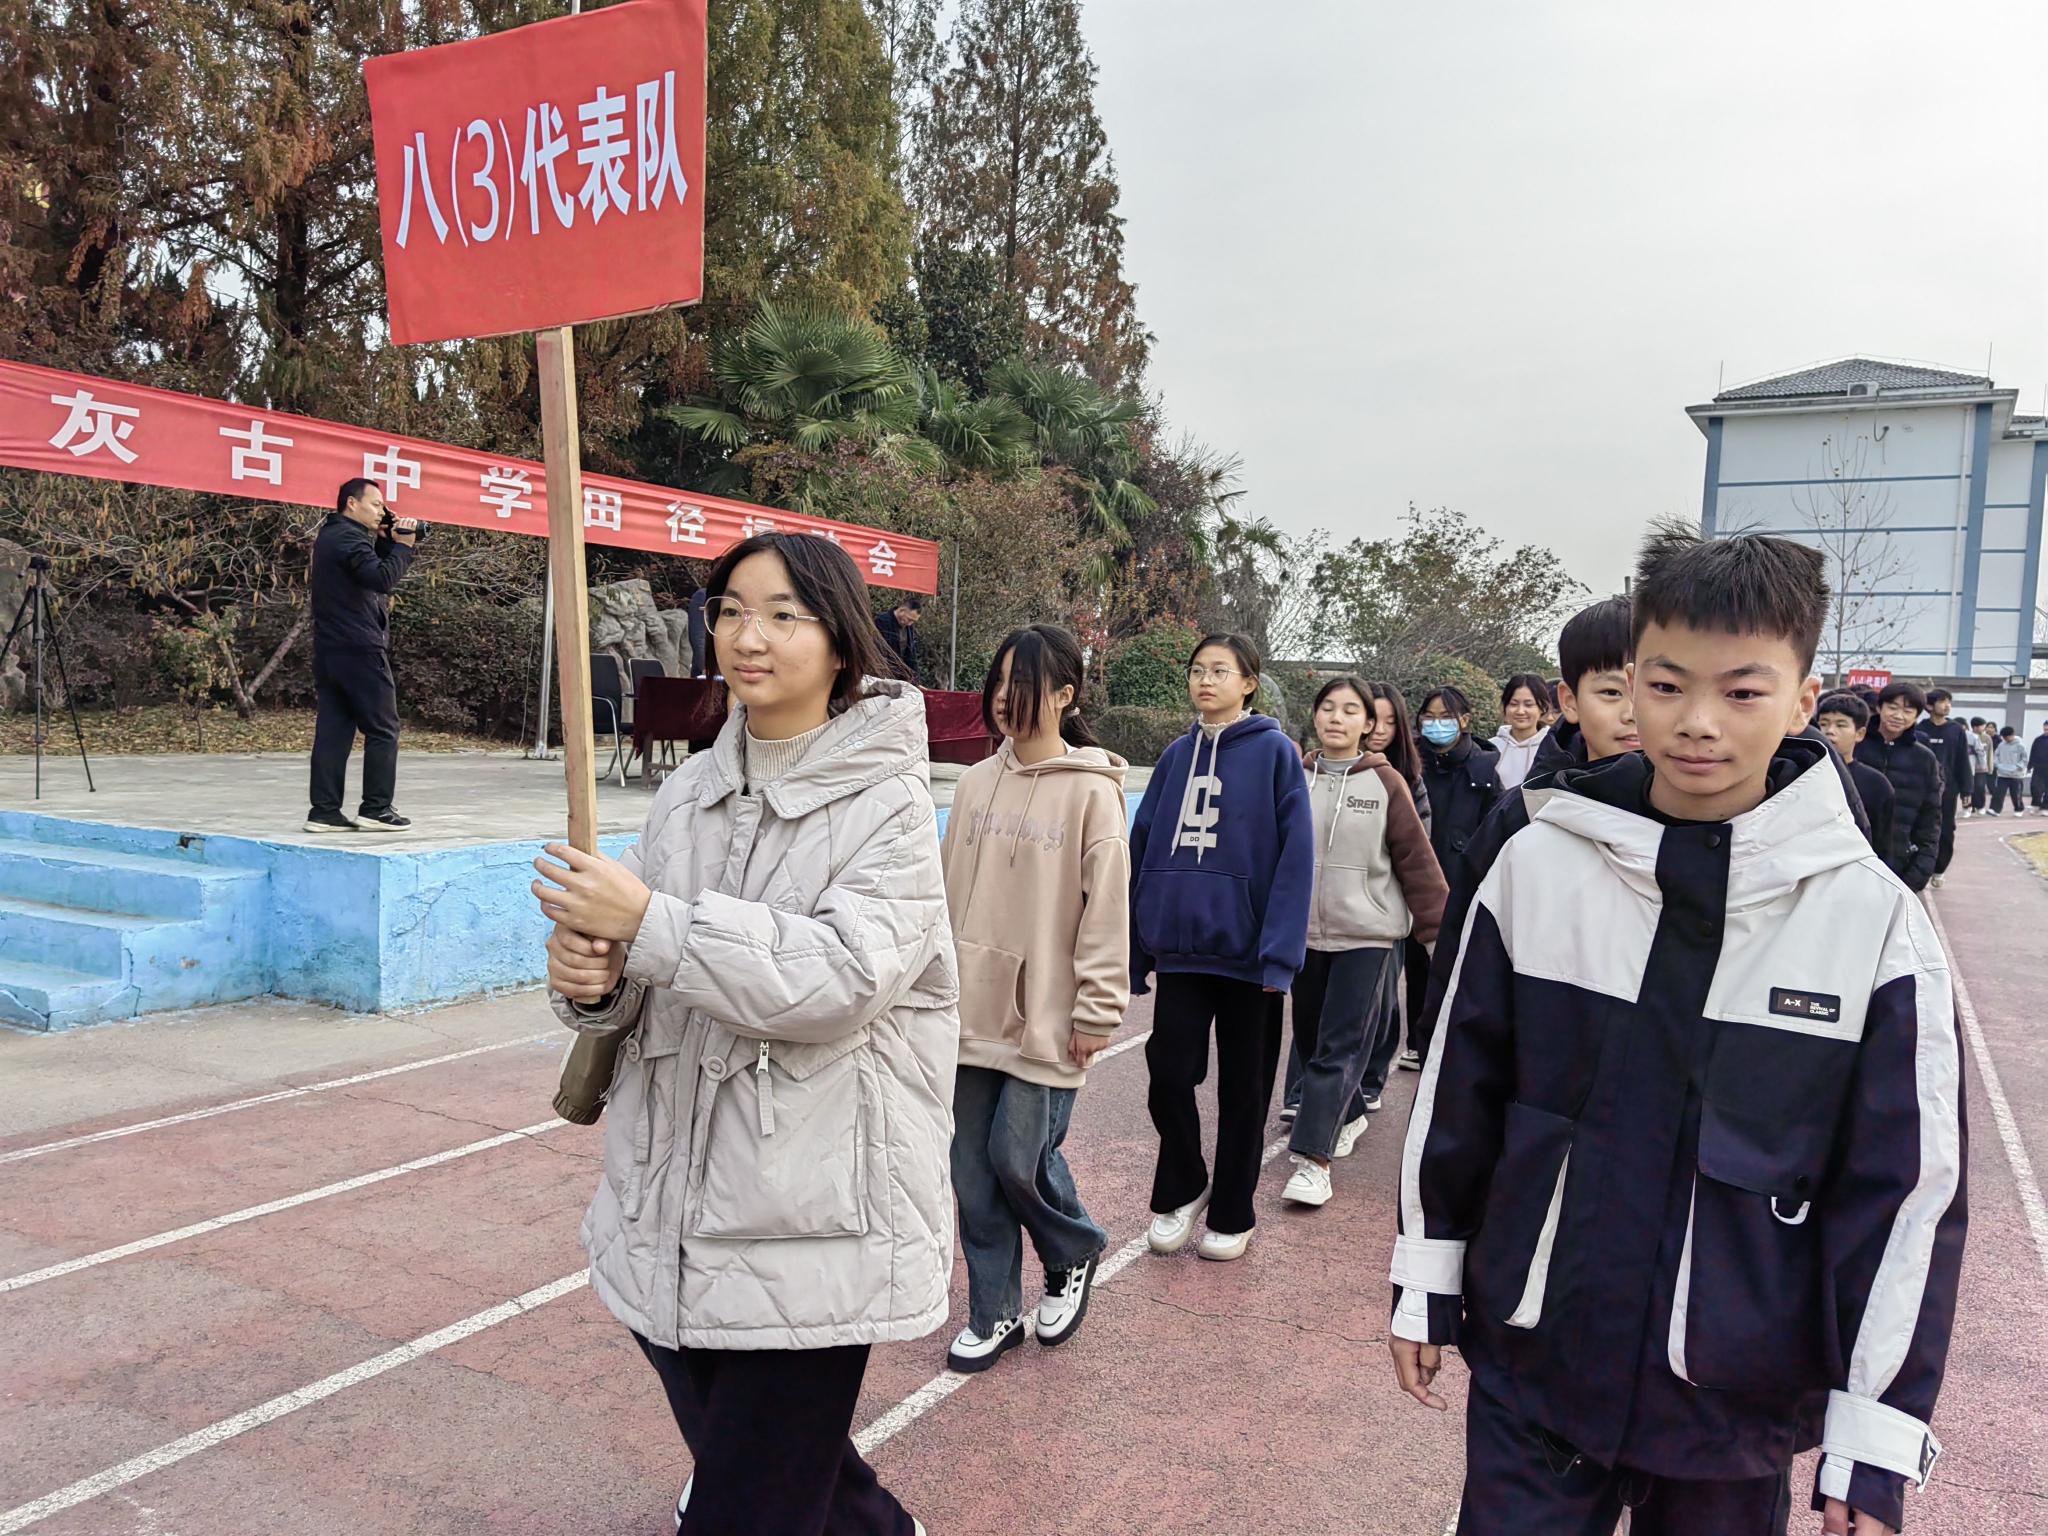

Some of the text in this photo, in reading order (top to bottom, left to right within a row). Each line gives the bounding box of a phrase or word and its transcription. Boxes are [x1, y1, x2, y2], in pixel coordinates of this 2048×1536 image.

[396, 71, 688, 249] 八(3)代表队
[48, 389, 897, 577] 灰古中学田径会
